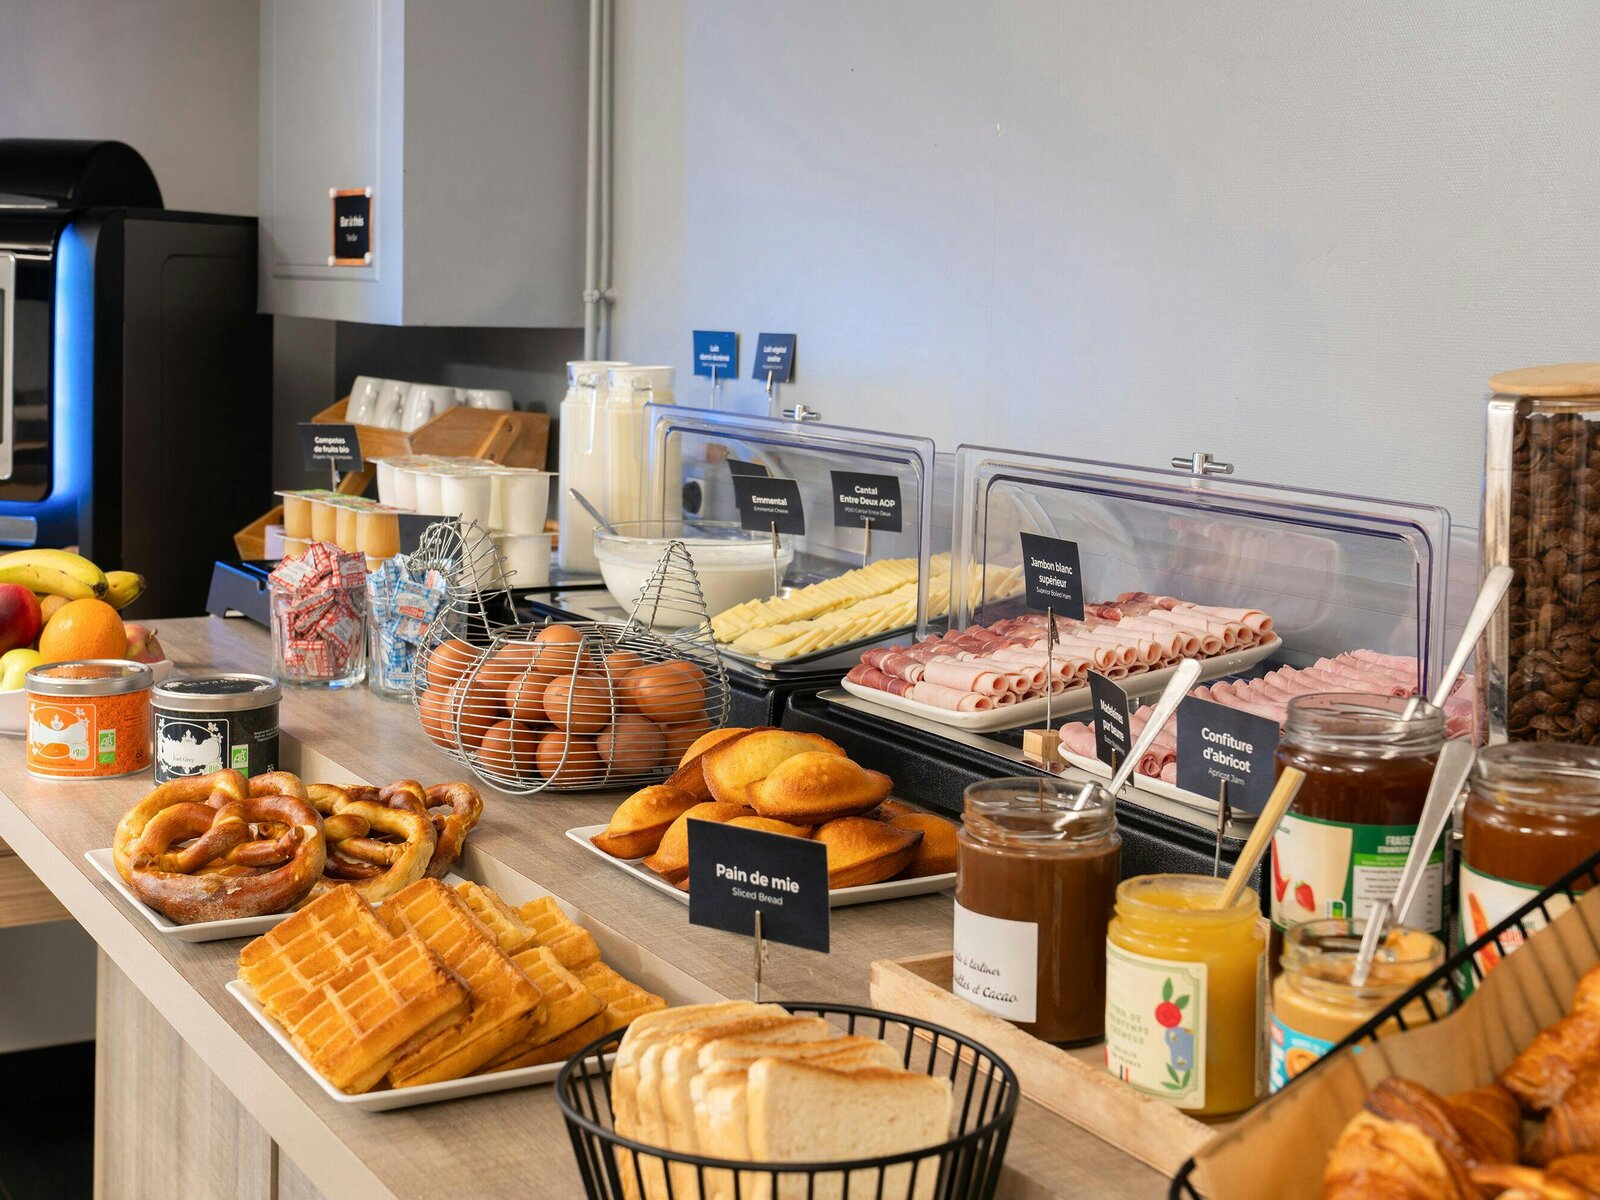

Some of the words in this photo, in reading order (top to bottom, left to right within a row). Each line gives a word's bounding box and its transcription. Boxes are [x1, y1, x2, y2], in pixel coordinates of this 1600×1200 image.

[314, 436, 346, 445] Compotes
[323, 445, 339, 453] fruits
[854, 485, 878, 495] Cantal
[752, 495, 787, 506] Emmental
[839, 494, 859, 504] Entre
[860, 496, 878, 506] Deux
[879, 499, 896, 507] AOP
[1030, 556, 1055, 571] Jambon
[1055, 562, 1073, 575] blanc
[1038, 574, 1067, 589] supérieur
[1036, 586, 1051, 596] Superior
[1051, 589, 1062, 598] Boiled
[1100, 698, 1124, 725] Madeleines
[1201, 727, 1253, 754] Confiture
[1202, 747, 1251, 773] d'abricot
[1208, 767, 1230, 780] Apricot
[1230, 774, 1245, 786] Jam
[716, 863, 747, 882] Pain
[750, 871, 769, 887] de
[771, 877, 800, 893] mie
[732, 886, 757, 900] Sliced
[758, 892, 783, 905] Bread
[969, 958, 1000, 976] tartiner
[972, 984, 980, 994] et
[982, 986, 1019, 1003] Cacao
